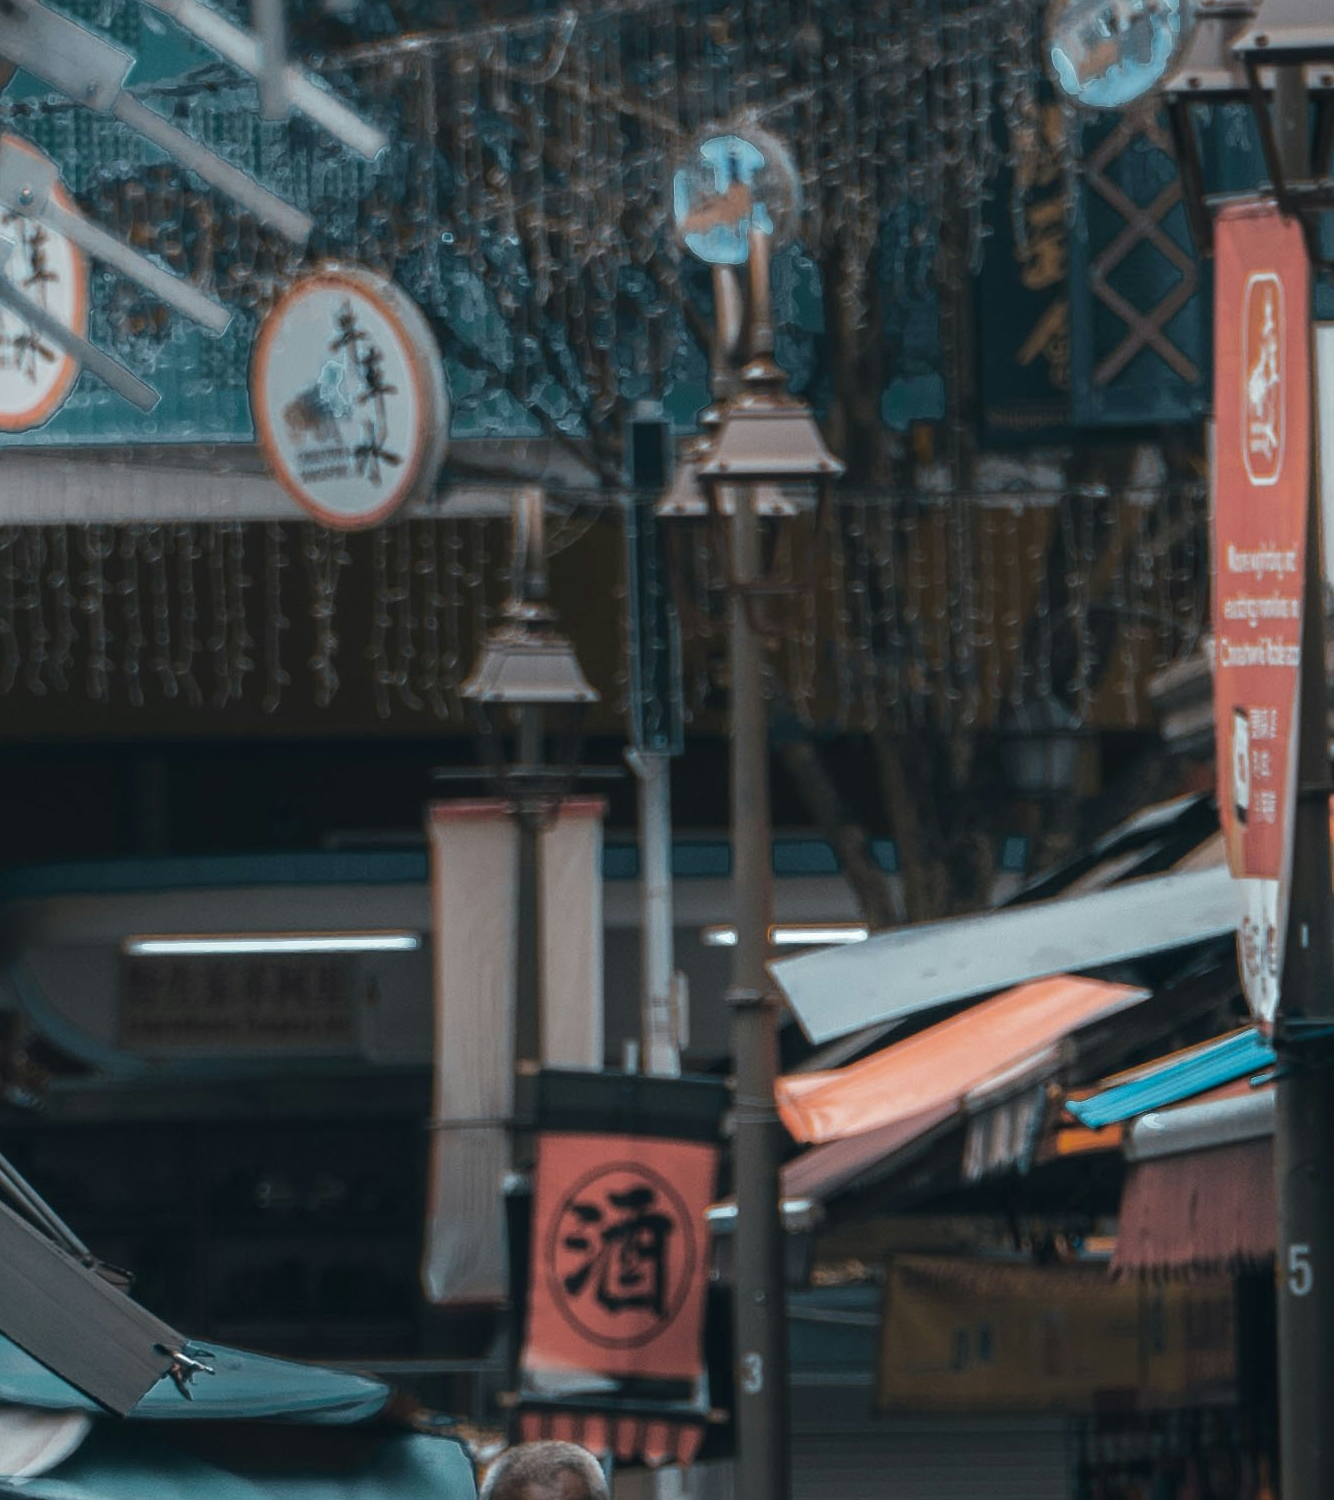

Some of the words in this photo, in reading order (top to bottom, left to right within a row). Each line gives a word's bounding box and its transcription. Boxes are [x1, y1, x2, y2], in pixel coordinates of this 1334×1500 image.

[564, 1185, 674, 1320] 酒
[1290, 1244, 1313, 1297] 5
[742, 1352, 763, 1394] 3
